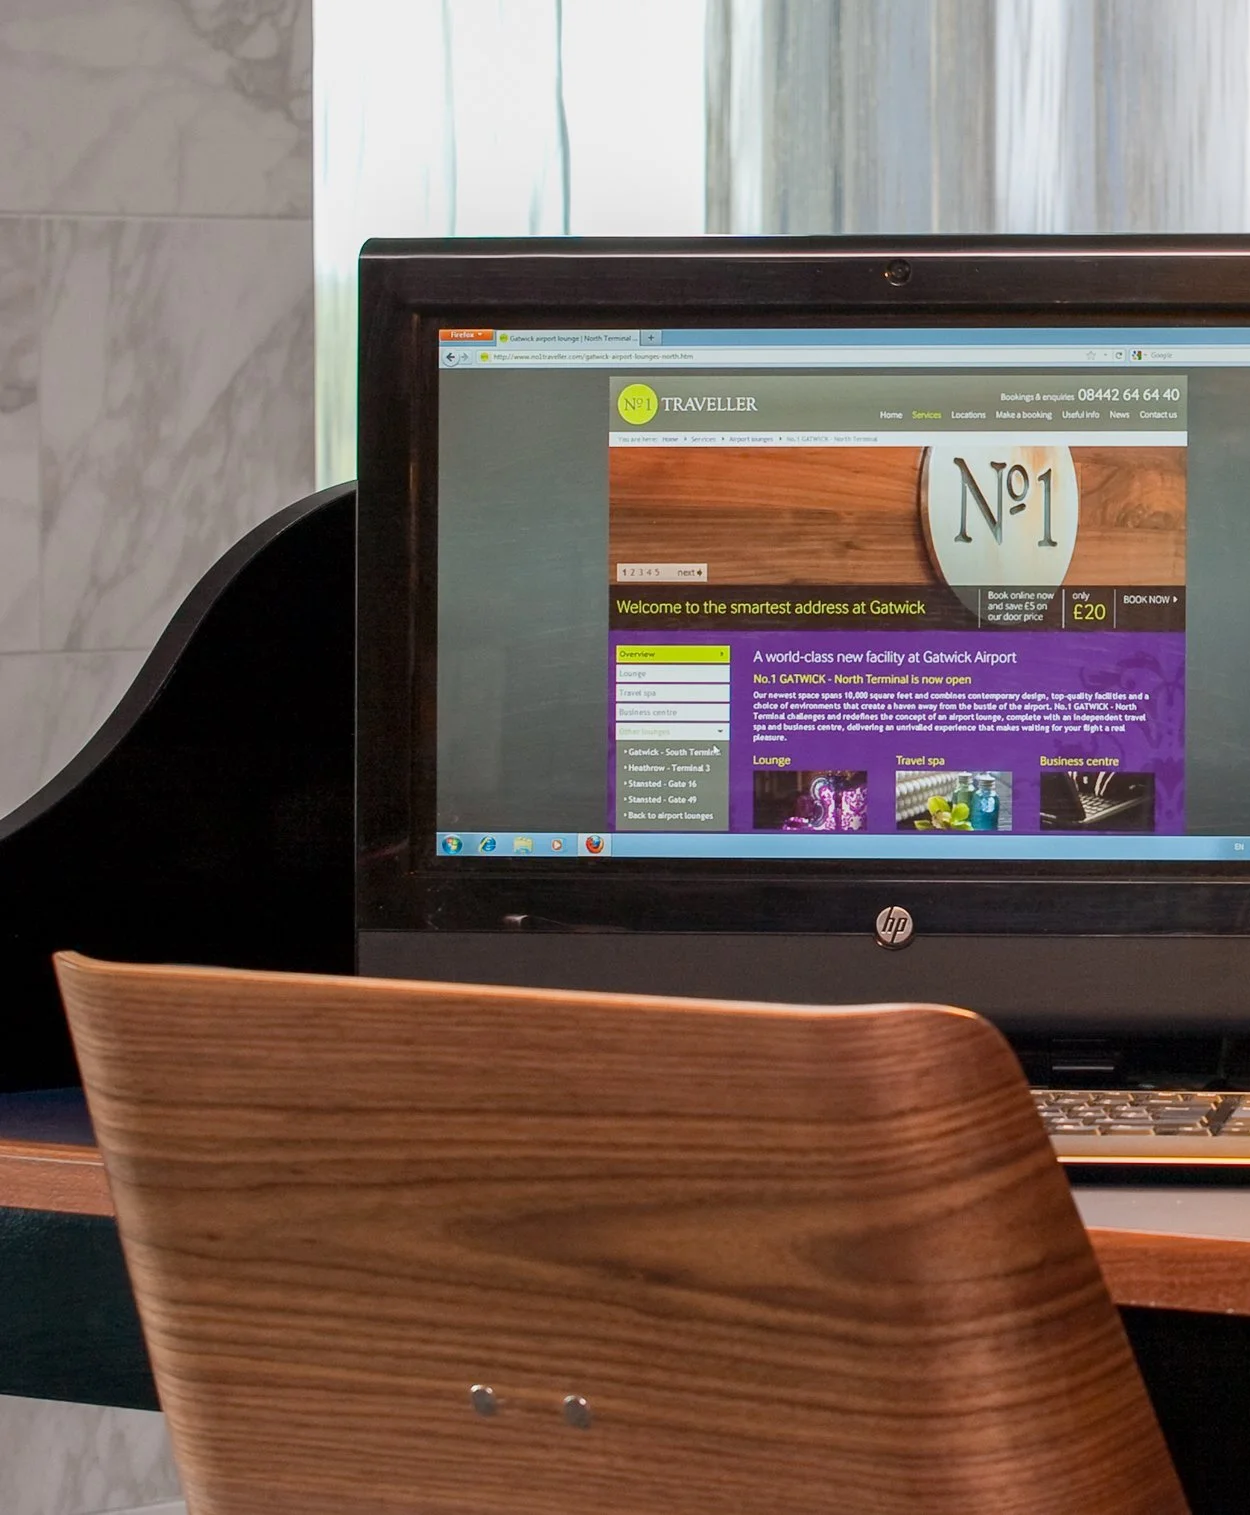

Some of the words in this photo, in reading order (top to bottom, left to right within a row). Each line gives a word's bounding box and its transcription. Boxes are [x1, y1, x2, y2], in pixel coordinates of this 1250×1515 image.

[451, 331, 474, 339] Firefox
[1001, 393, 1034, 402] Bookings
[1042, 393, 1075, 402] enquiries
[1078, 389, 1119, 401] 08442
[1123, 389, 1139, 401] 64
[1143, 389, 1160, 401] 64
[1163, 388, 1180, 401] 40
[661, 396, 758, 412] TRAVELLER
[880, 411, 903, 419] Home
[912, 410, 942, 420] Services
[1022, 411, 1052, 420] booking
[1062, 411, 1084, 419] Useful
[677, 568, 695, 577] next
[988, 591, 1008, 600] Book
[1010, 591, 1035, 600] online
[1072, 592, 1090, 601] only
[1124, 595, 1147, 604] BOOK
[1149, 595, 1170, 604] NOW
[617, 600, 681, 614] Welcome
[686, 602, 699, 614] to
[703, 600, 726, 614] the
[731, 602, 791, 615] smartest
[795, 600, 849, 614] address
[852, 602, 866, 614] at
[870, 600, 925, 614] Gatwick
[988, 602, 1003, 610] and
[1024, 602, 1035, 610] £5
[1003, 612, 1023, 621] door
[1024, 613, 1043, 622] price
[1073, 604, 1106, 621] £20
[619, 650, 655, 658] Overview
[753, 651, 763, 662] A
[766, 651, 834, 663] world-class
[837, 653, 863, 663] new
[866, 651, 905, 666] facility
[908, 652, 920, 663] at
[923, 651, 972, 663] Gatwick
[974, 651, 1017, 665] Airport
[619, 670, 647, 679] Lounge
[754, 673, 776, 684] No.1
[780, 673, 826, 685] GATWICK
[834, 674, 863, 684] North
[866, 674, 909, 684] Terminal
[910, 675, 920, 684] is
[946, 677, 971, 686] open
[644, 690, 657, 698] spa
[798, 693, 820, 701] space
[821, 693, 842, 701] spans
[845, 692, 868, 701] 10,000
[870, 693, 895, 701] square
[968, 692, 1020, 701] contemporary
[1021, 693, 1049, 701] design,
[1051, 693, 1093, 701] top-quality
[790, 702, 841, 710] environments
[843, 702, 859, 710] that
[1024, 703, 1052, 712] airport.
[619, 708, 651, 716] Business
[753, 734, 787, 742] pleasure.
[629, 748, 659, 756] Gatwick
[666, 748, 687, 756] South
[753, 755, 791, 767] Lounge
[896, 755, 925, 765] Travel
[928, 758, 945, 767] spa
[1040, 756, 1084, 766] Business
[1085, 757, 1119, 766] centre
[628, 764, 665, 772] Heathrow
[706, 764, 710, 772] 3
[658, 812, 683, 820] airport
[684, 812, 713, 821] lounges
[879, 906, 909, 943] hp
